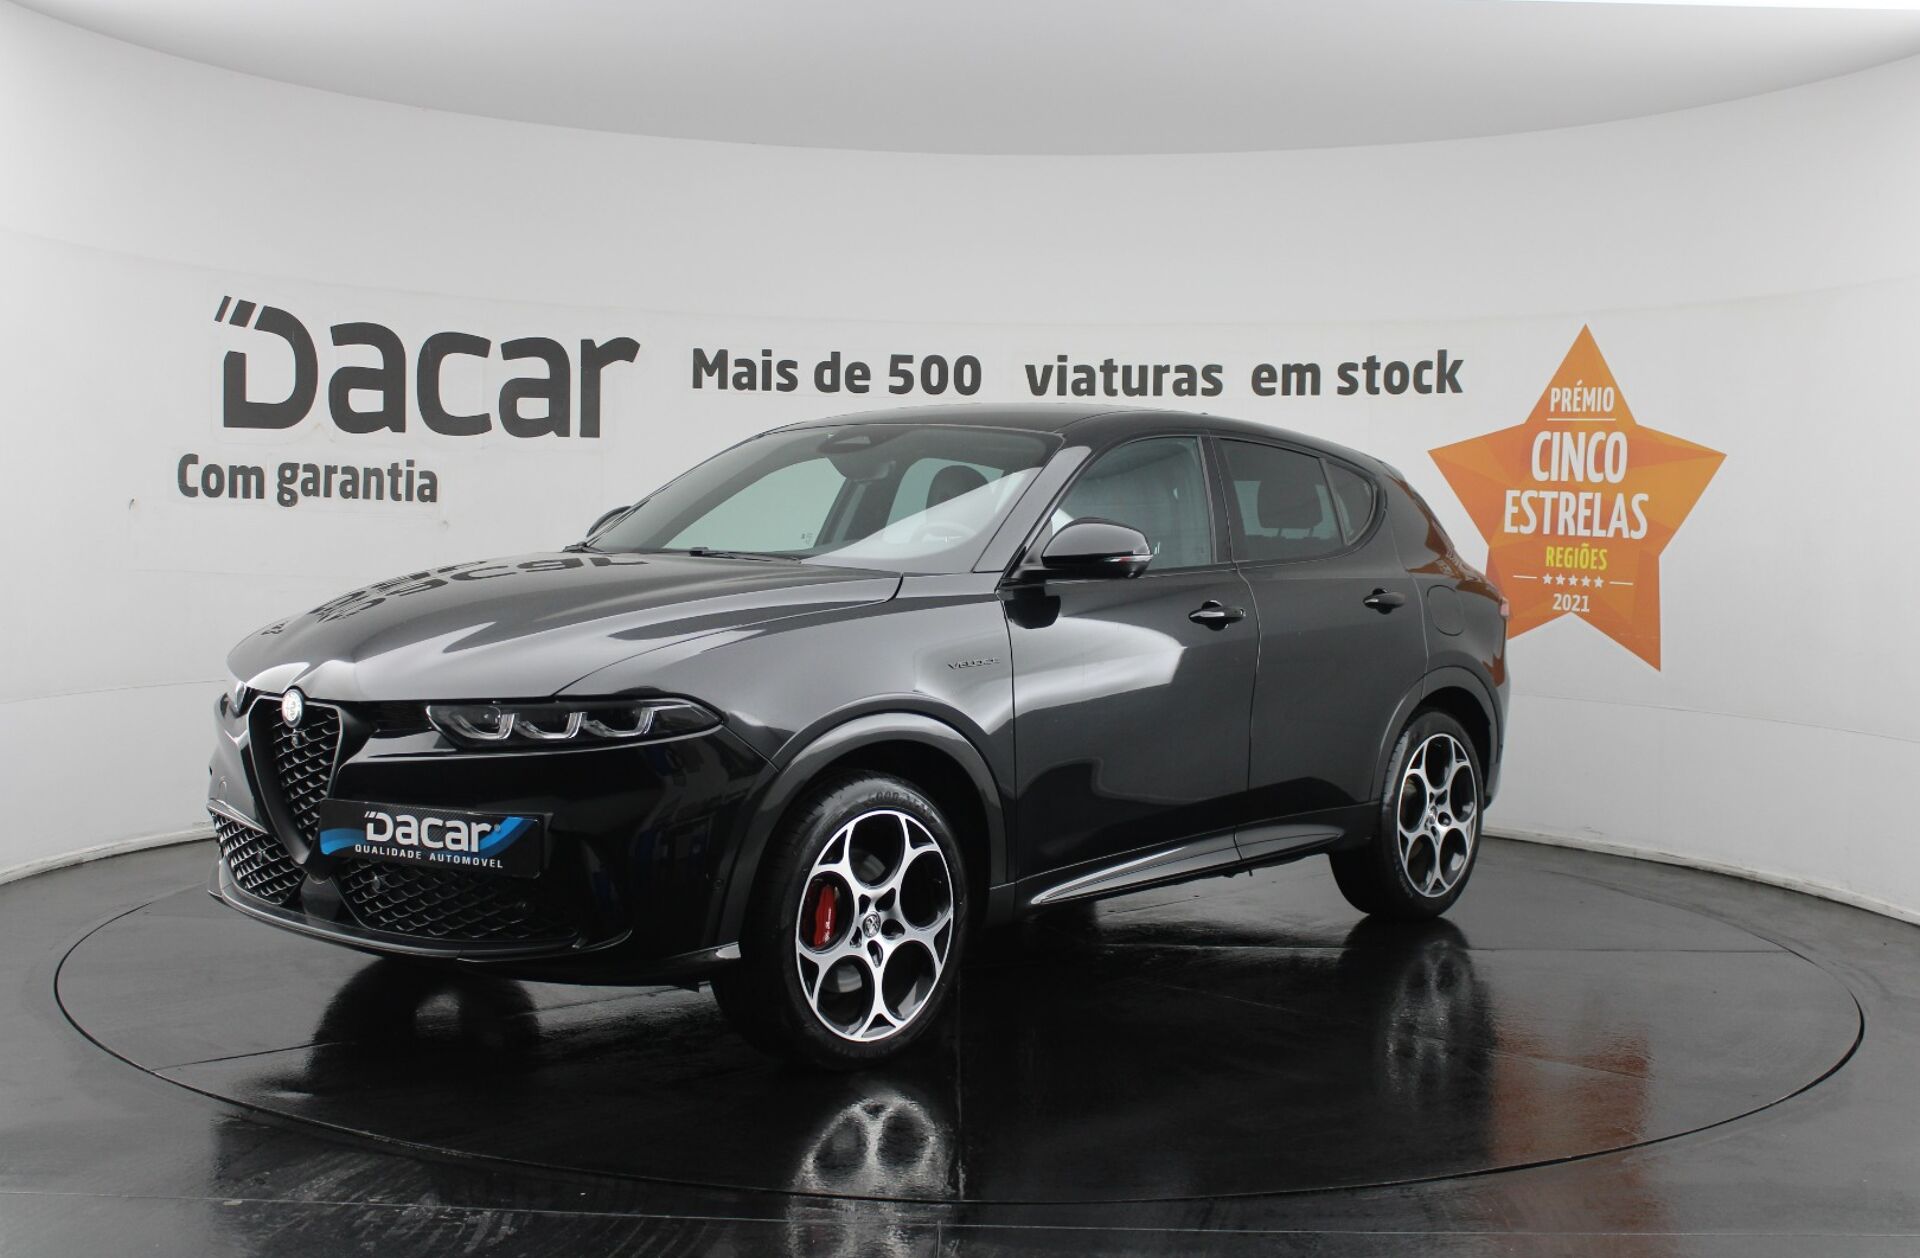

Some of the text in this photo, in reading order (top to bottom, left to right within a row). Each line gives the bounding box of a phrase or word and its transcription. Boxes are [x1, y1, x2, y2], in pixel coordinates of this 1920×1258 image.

[214, 295, 641, 438] Dacar
[692, 347, 1464, 397] Mais de 500 viaturas em stock
[1549, 380, 1615, 412] PRÉMIO
[177, 453, 438, 508] Com garantia
[1531, 431, 1628, 484] CINCO
[1503, 490, 1649, 540] ESTRELAS
[1545, 543, 1608, 571] REGIÕES
[1552, 593, 1590, 613] 2021
[363, 810, 492, 853] Dacar
[354, 844, 504, 869] QUALIDADE AUTOMOVEL
